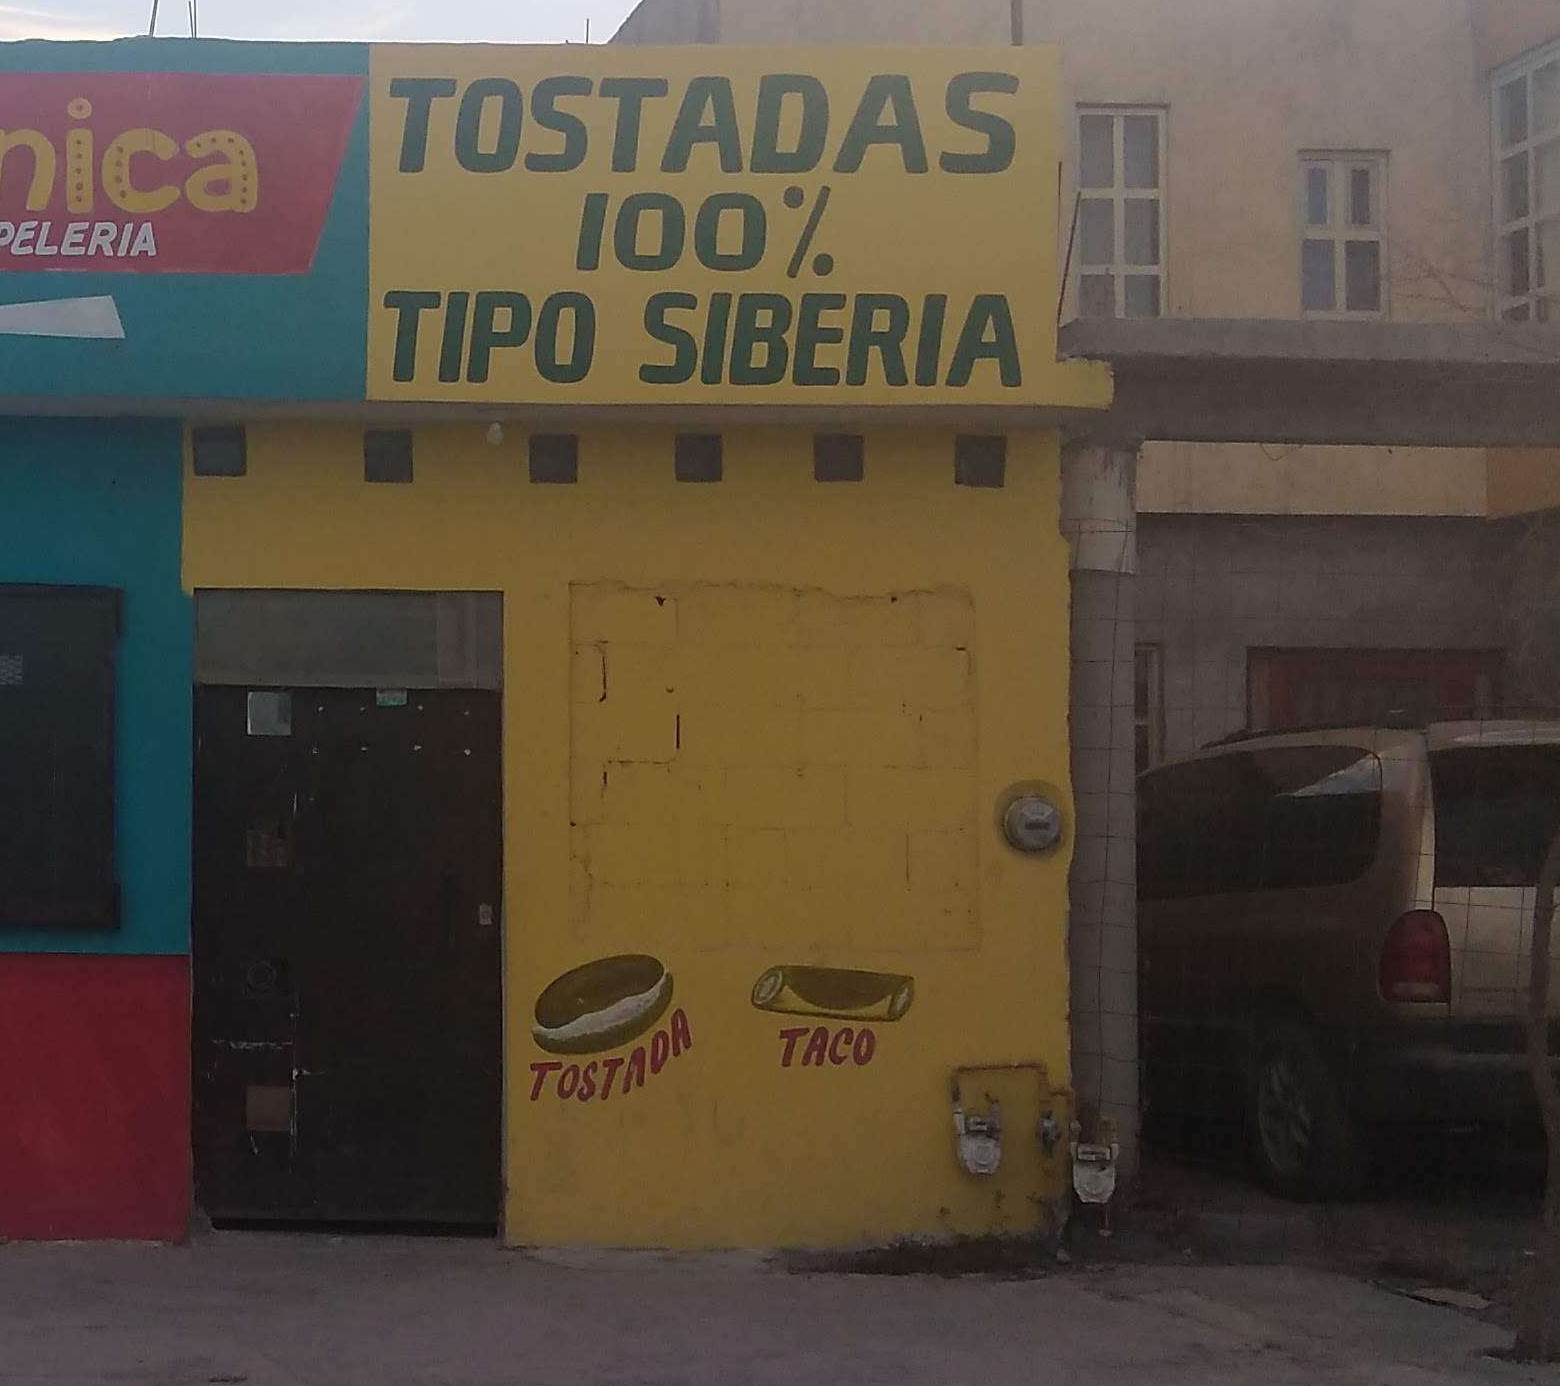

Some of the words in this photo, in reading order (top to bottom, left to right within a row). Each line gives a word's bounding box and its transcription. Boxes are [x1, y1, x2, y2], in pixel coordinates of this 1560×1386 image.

[389, 72, 1020, 175] TOSTADAS
[576, 185, 834, 279] 100%
[383, 290, 596, 384] TIPO
[638, 291, 1023, 388] SIBERIA
[529, 1008, 693, 1102] TOSTADA
[779, 1027, 876, 1067] TACO
